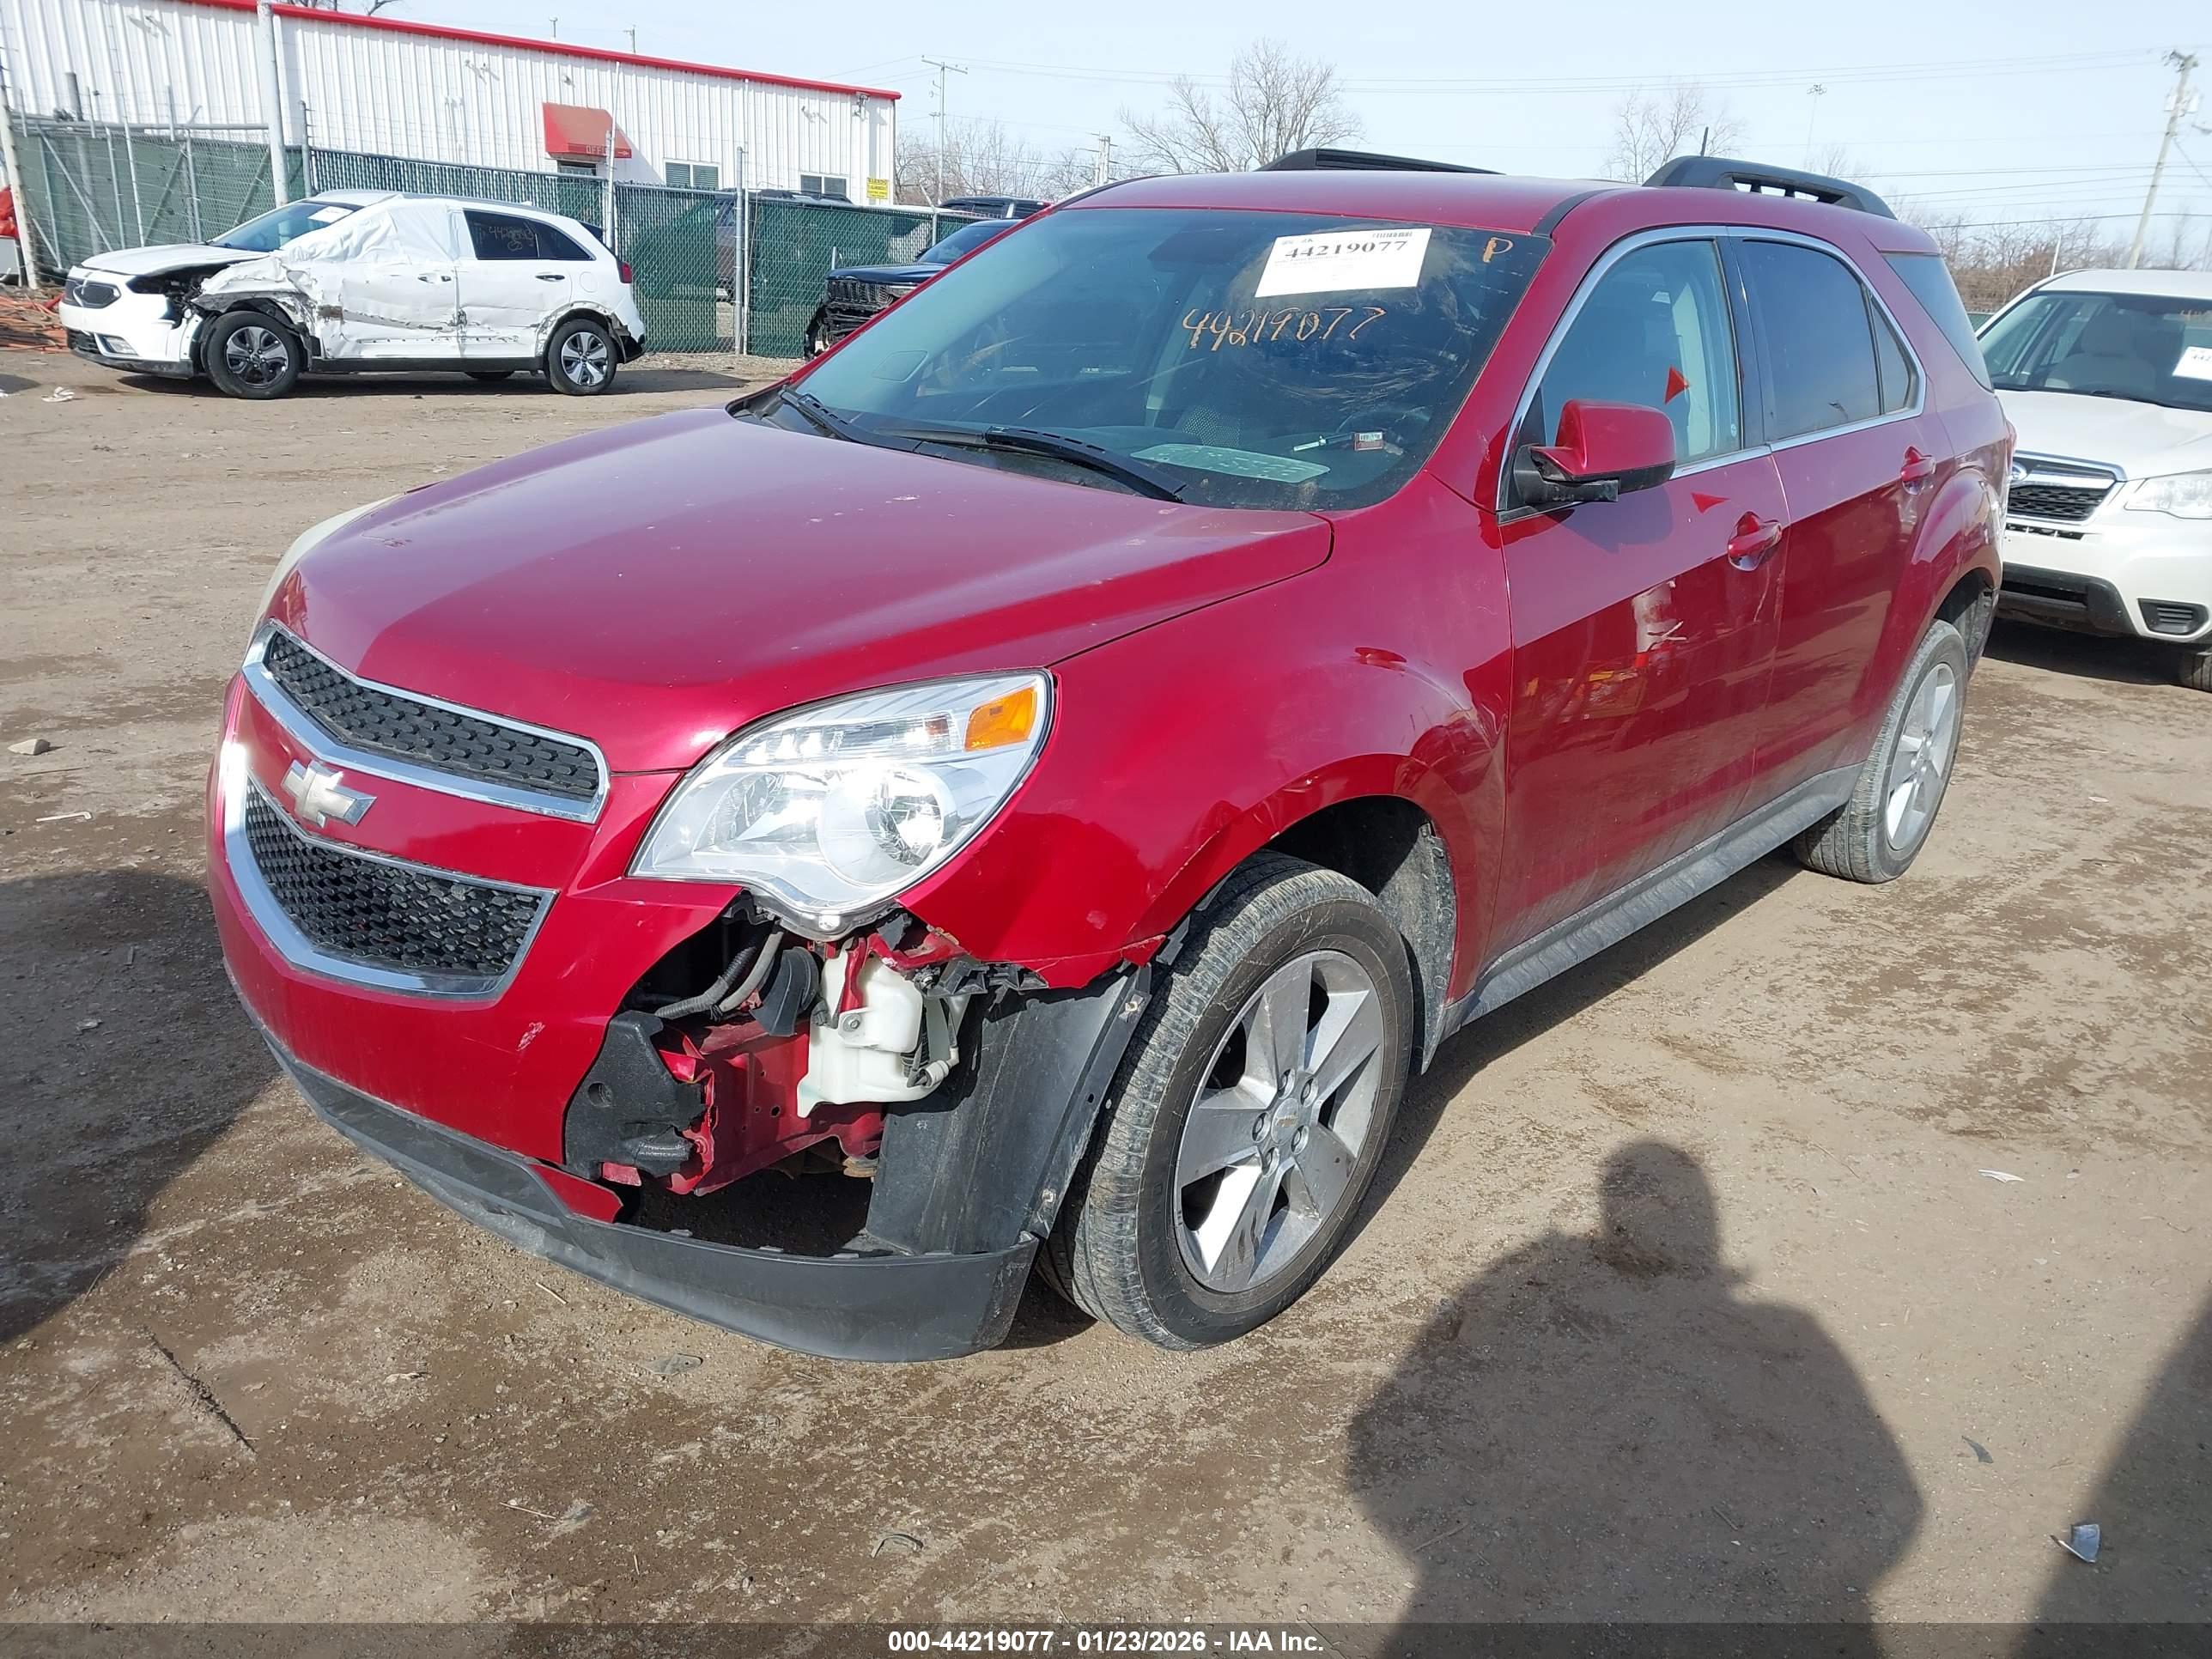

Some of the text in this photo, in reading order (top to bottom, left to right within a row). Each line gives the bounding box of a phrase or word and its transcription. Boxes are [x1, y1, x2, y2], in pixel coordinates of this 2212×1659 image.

[586, 145, 608, 156] OFFI
[1285, 240, 1408, 258] 44219077
[1483, 236, 1514, 264] P
[1182, 307, 1388, 351] 44219077
